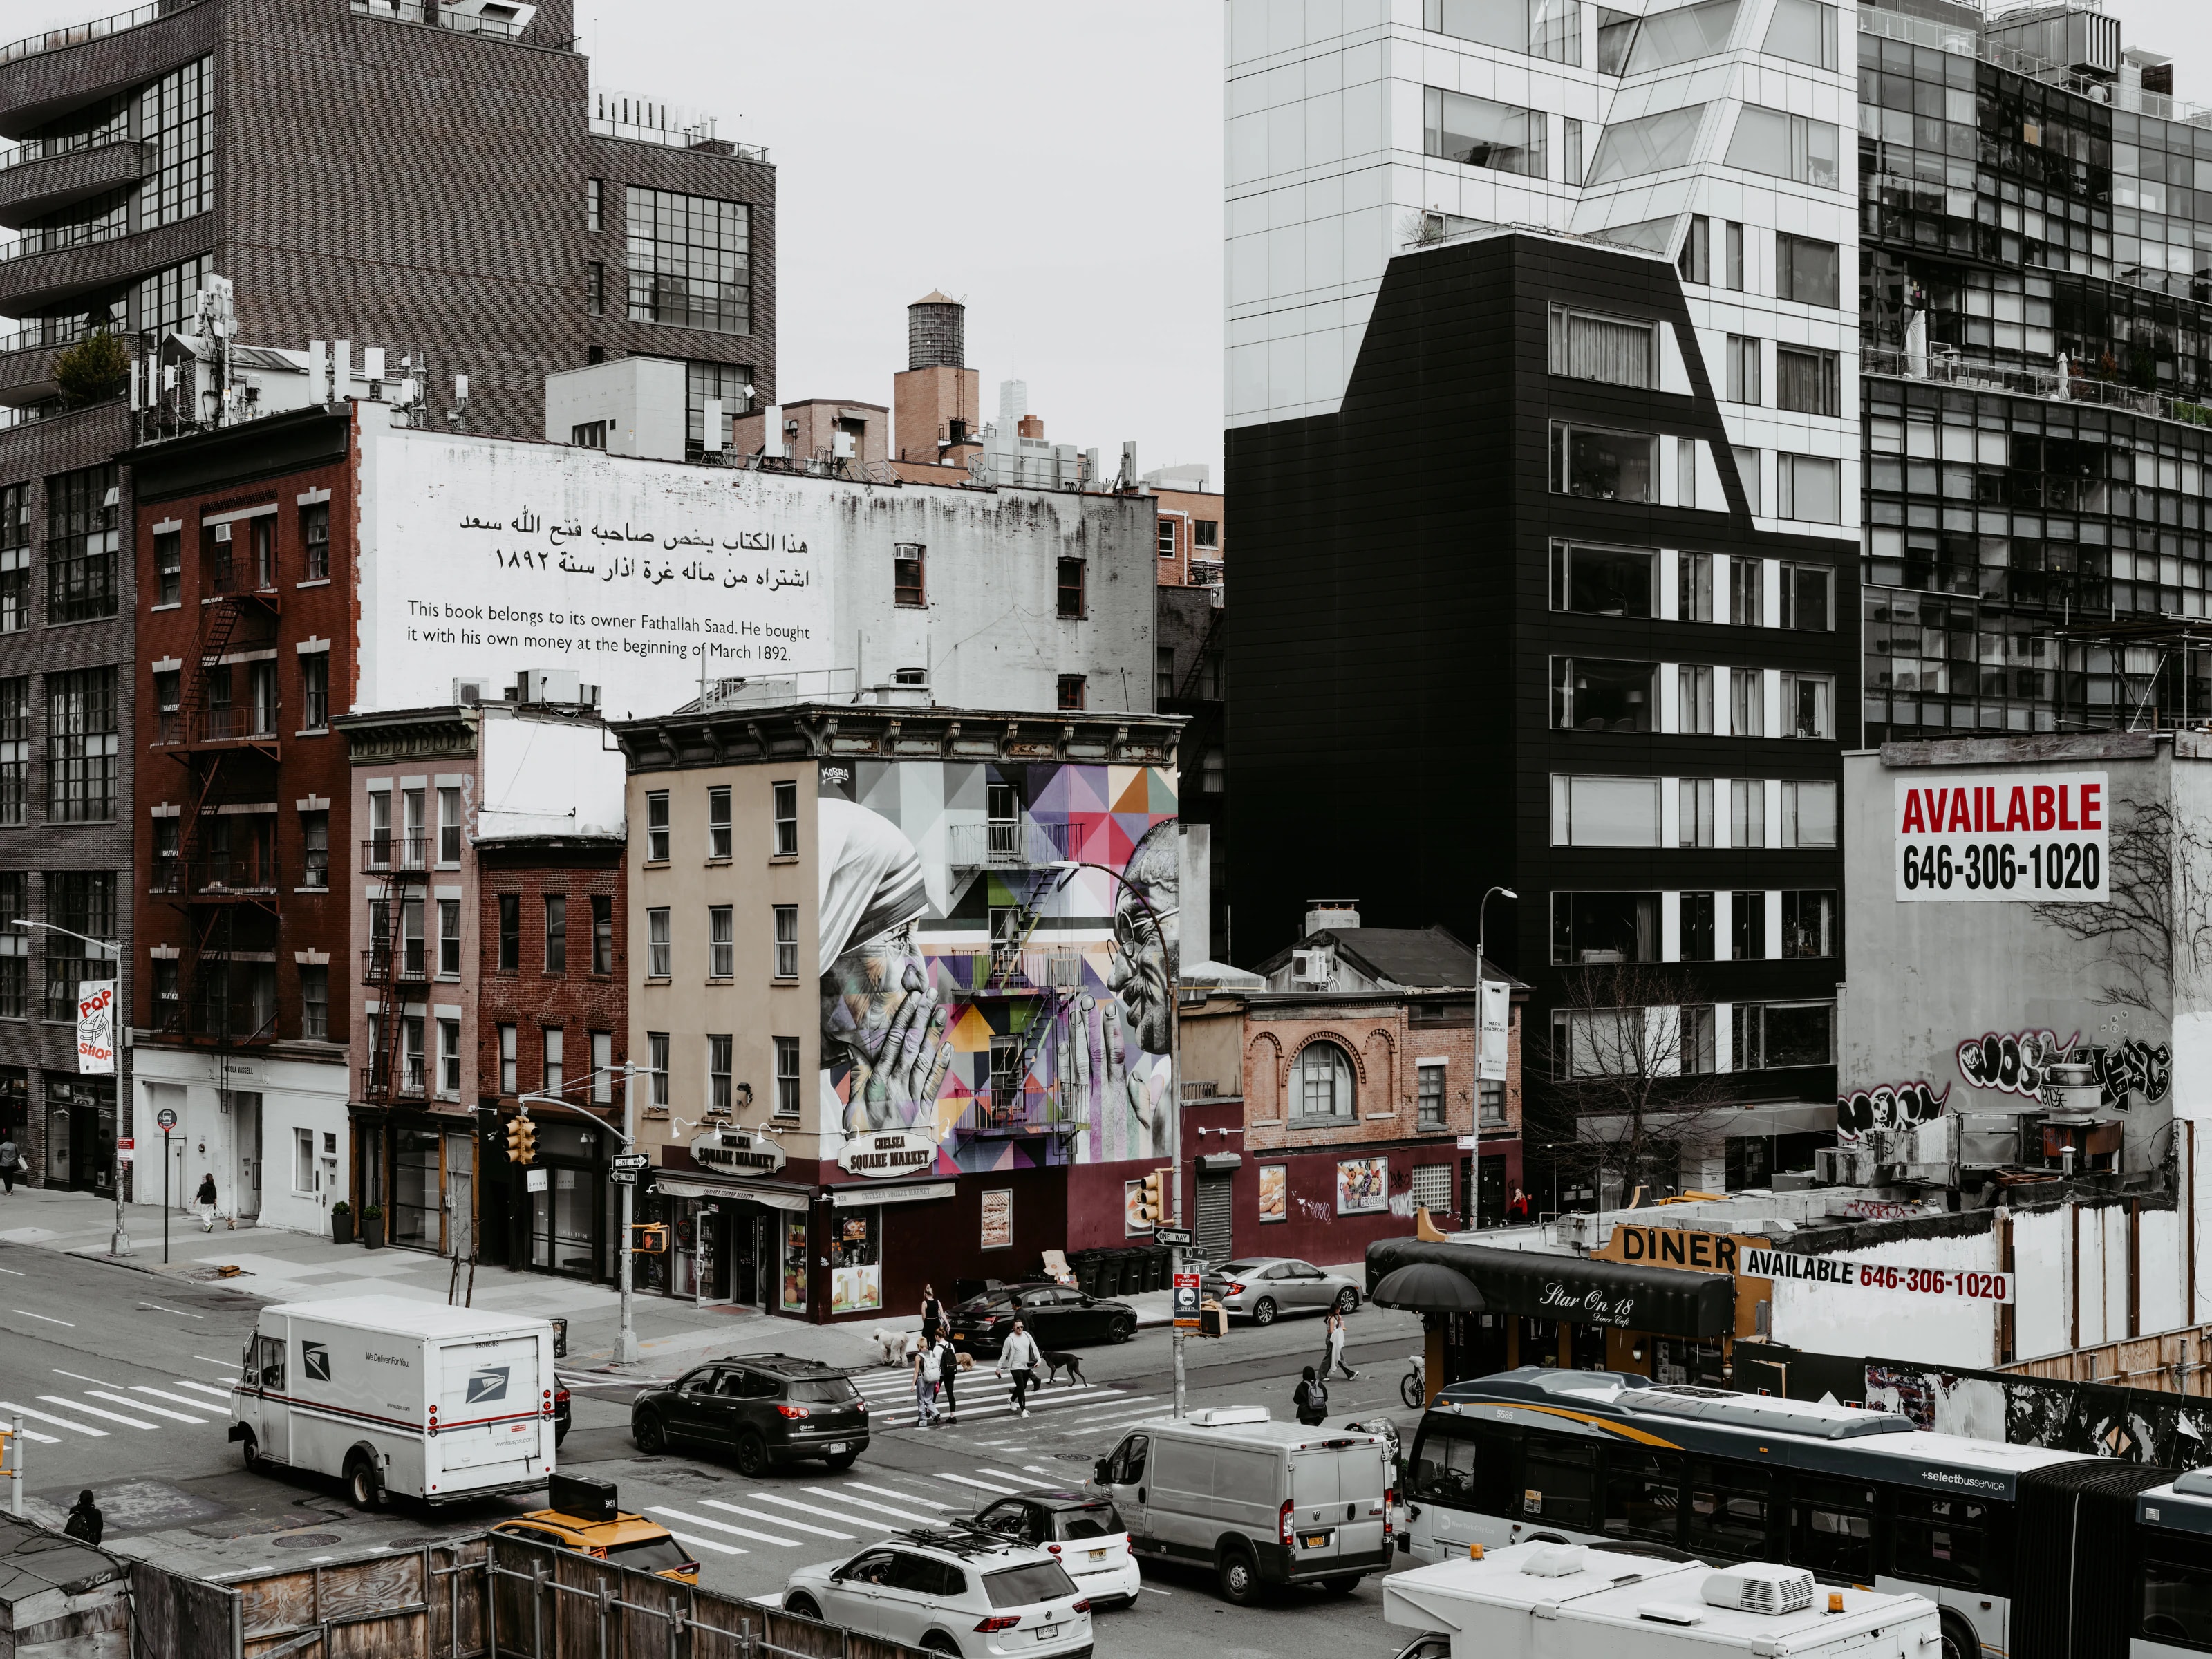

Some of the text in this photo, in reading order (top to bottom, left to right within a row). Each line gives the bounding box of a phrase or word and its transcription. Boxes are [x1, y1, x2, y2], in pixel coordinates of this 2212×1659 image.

[460, 515, 502, 530] سعد
[550, 518, 581, 546] فتح
[592, 522, 654, 545] صاحبه
[723, 531, 774, 550] الكتاب
[664, 529, 713, 553] يخص
[782, 534, 808, 553] هذا
[496, 548, 809, 591] اشتراه من ماله غرة اذار سنة ١٨٩٢
[408, 600, 810, 643] This book belongs to its owner Fathallah Saad. He bought
[407, 626, 791, 662] it with his own money at the beginning of March 1892.
[821, 767, 849, 778] KOBRA
[1902, 783, 2101, 834] AVAILABLE
[1904, 843, 2100, 890] 646-306-1020
[79, 990, 112, 1018] POP
[79, 1042, 112, 1061] SHOP
[224, 1065, 254, 1075] NCOLA VASSELL
[721, 1134, 751, 1149] CHELSEA
[874, 1136, 906, 1150] CHELSEA
[698, 1147, 775, 1170] SQUARE MARKET
[850, 1150, 930, 1170] SQUARE MARKET
[862, 1188, 930, 1201] CHELSEA SQUARE MARKET
[1361, 1196, 1385, 1206] GROCERIES
[1159, 1232, 1188, 1242] ONE WAY
[1185, 1248, 1194, 1258] 10
[1623, 1228, 1737, 1273] DINER
[1184, 1266, 1190, 1274] W
[1193, 1265, 1200, 1274] 18
[1747, 1250, 2006, 1301] AVAILABLE 646-306-1020
[1539, 1282, 1635, 1315] Star On 18
[1592, 1312, 1631, 1328] Diner Café
[475, 1341, 500, 1349] 5500583
[366, 1352, 410, 1368] We Deliver For You.
[387, 1403, 411, 1412] www.usps.com
[1497, 1409, 1514, 1420] 5585
[495, 1438, 535, 1447] www.usps.com
[1452, 1521, 1462, 1529] New
[1463, 1523, 1474, 1531] York
[1474, 1525, 1485, 1534] City
